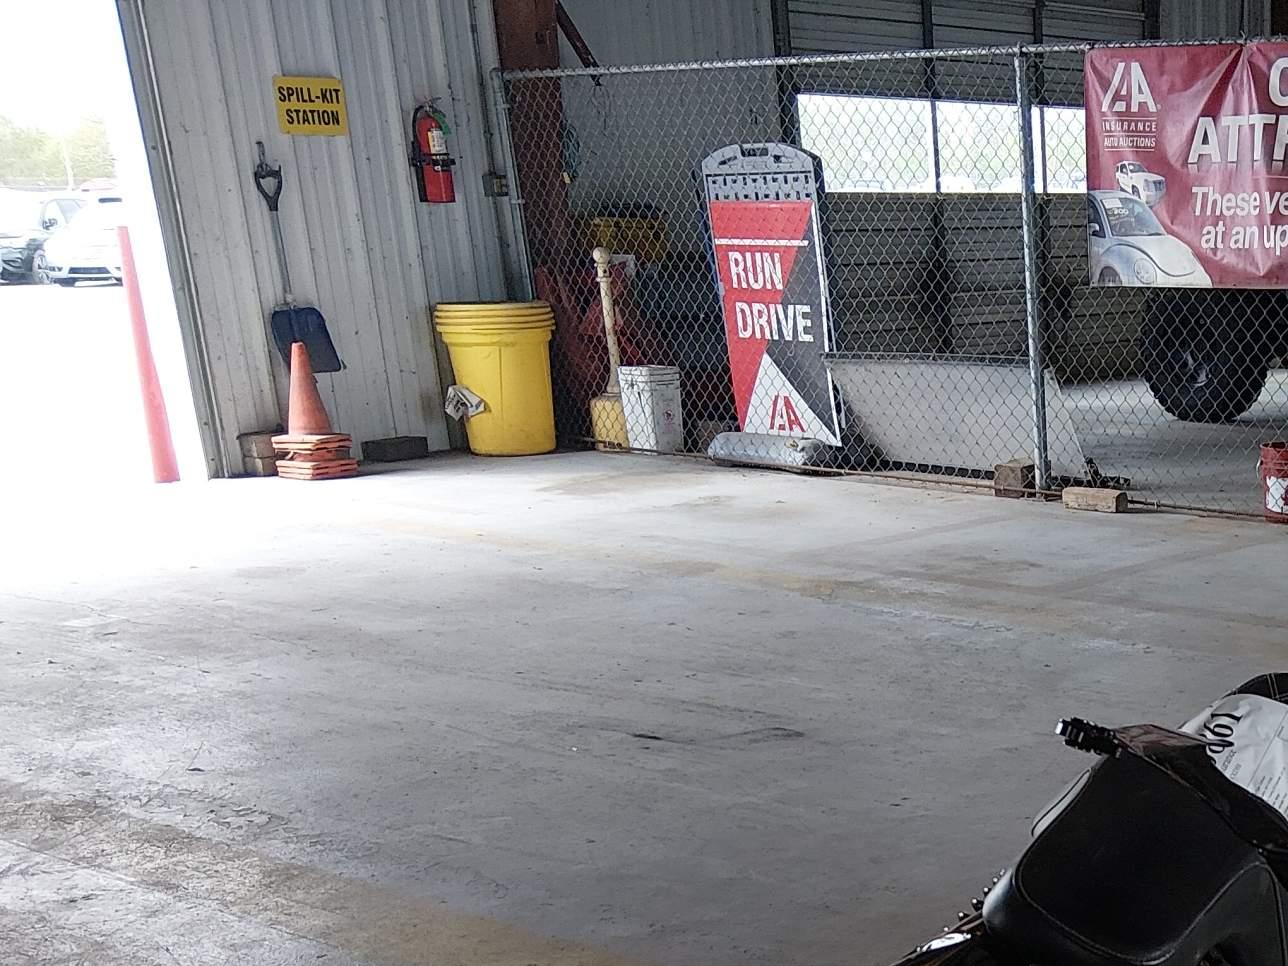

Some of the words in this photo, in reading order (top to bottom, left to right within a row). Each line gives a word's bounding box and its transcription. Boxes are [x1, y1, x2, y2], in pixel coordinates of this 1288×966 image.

[277, 86, 341, 104] SPILL-KIT
[285, 109, 340, 126] STATION
[1102, 121, 1157, 131] INSURANCE
[1119, 136, 1156, 147] AUCTIONS
[1192, 186, 1260, 217] These
[1201, 220, 1225, 249] at
[1230, 225, 1258, 249] an
[728, 251, 784, 290] RUN
[735, 301, 814, 342] DRIVE
